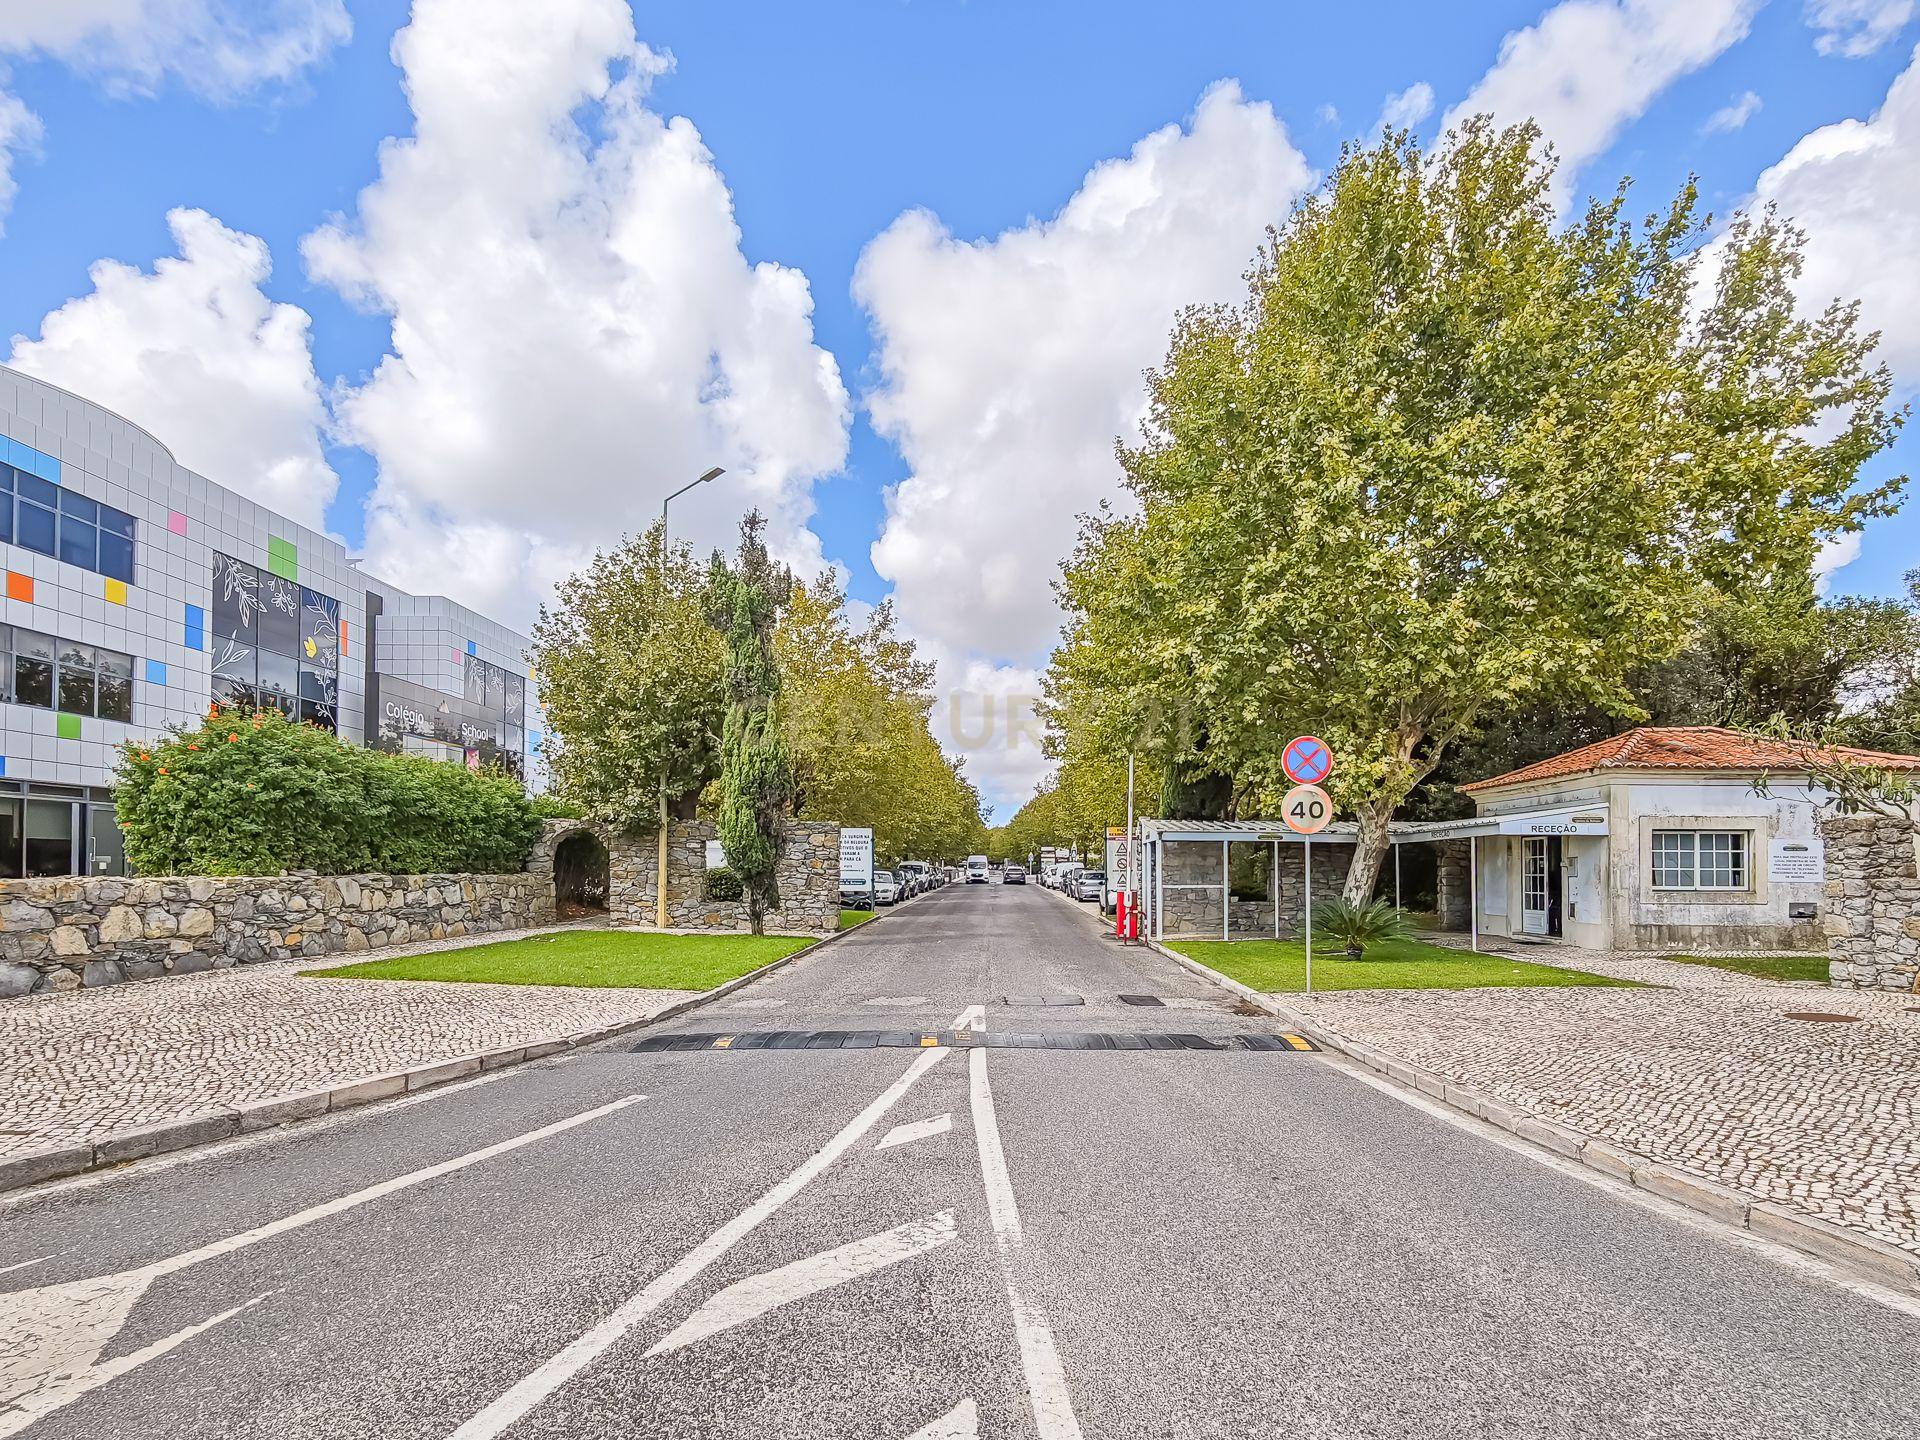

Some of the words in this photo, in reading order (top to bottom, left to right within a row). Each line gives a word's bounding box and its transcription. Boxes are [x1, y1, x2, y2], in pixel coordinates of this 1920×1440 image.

[386, 701, 425, 726] Colégio
[461, 722, 489, 741] School
[1290, 801, 1324, 819] 40
[1531, 824, 1578, 834] RECEÇÃO
